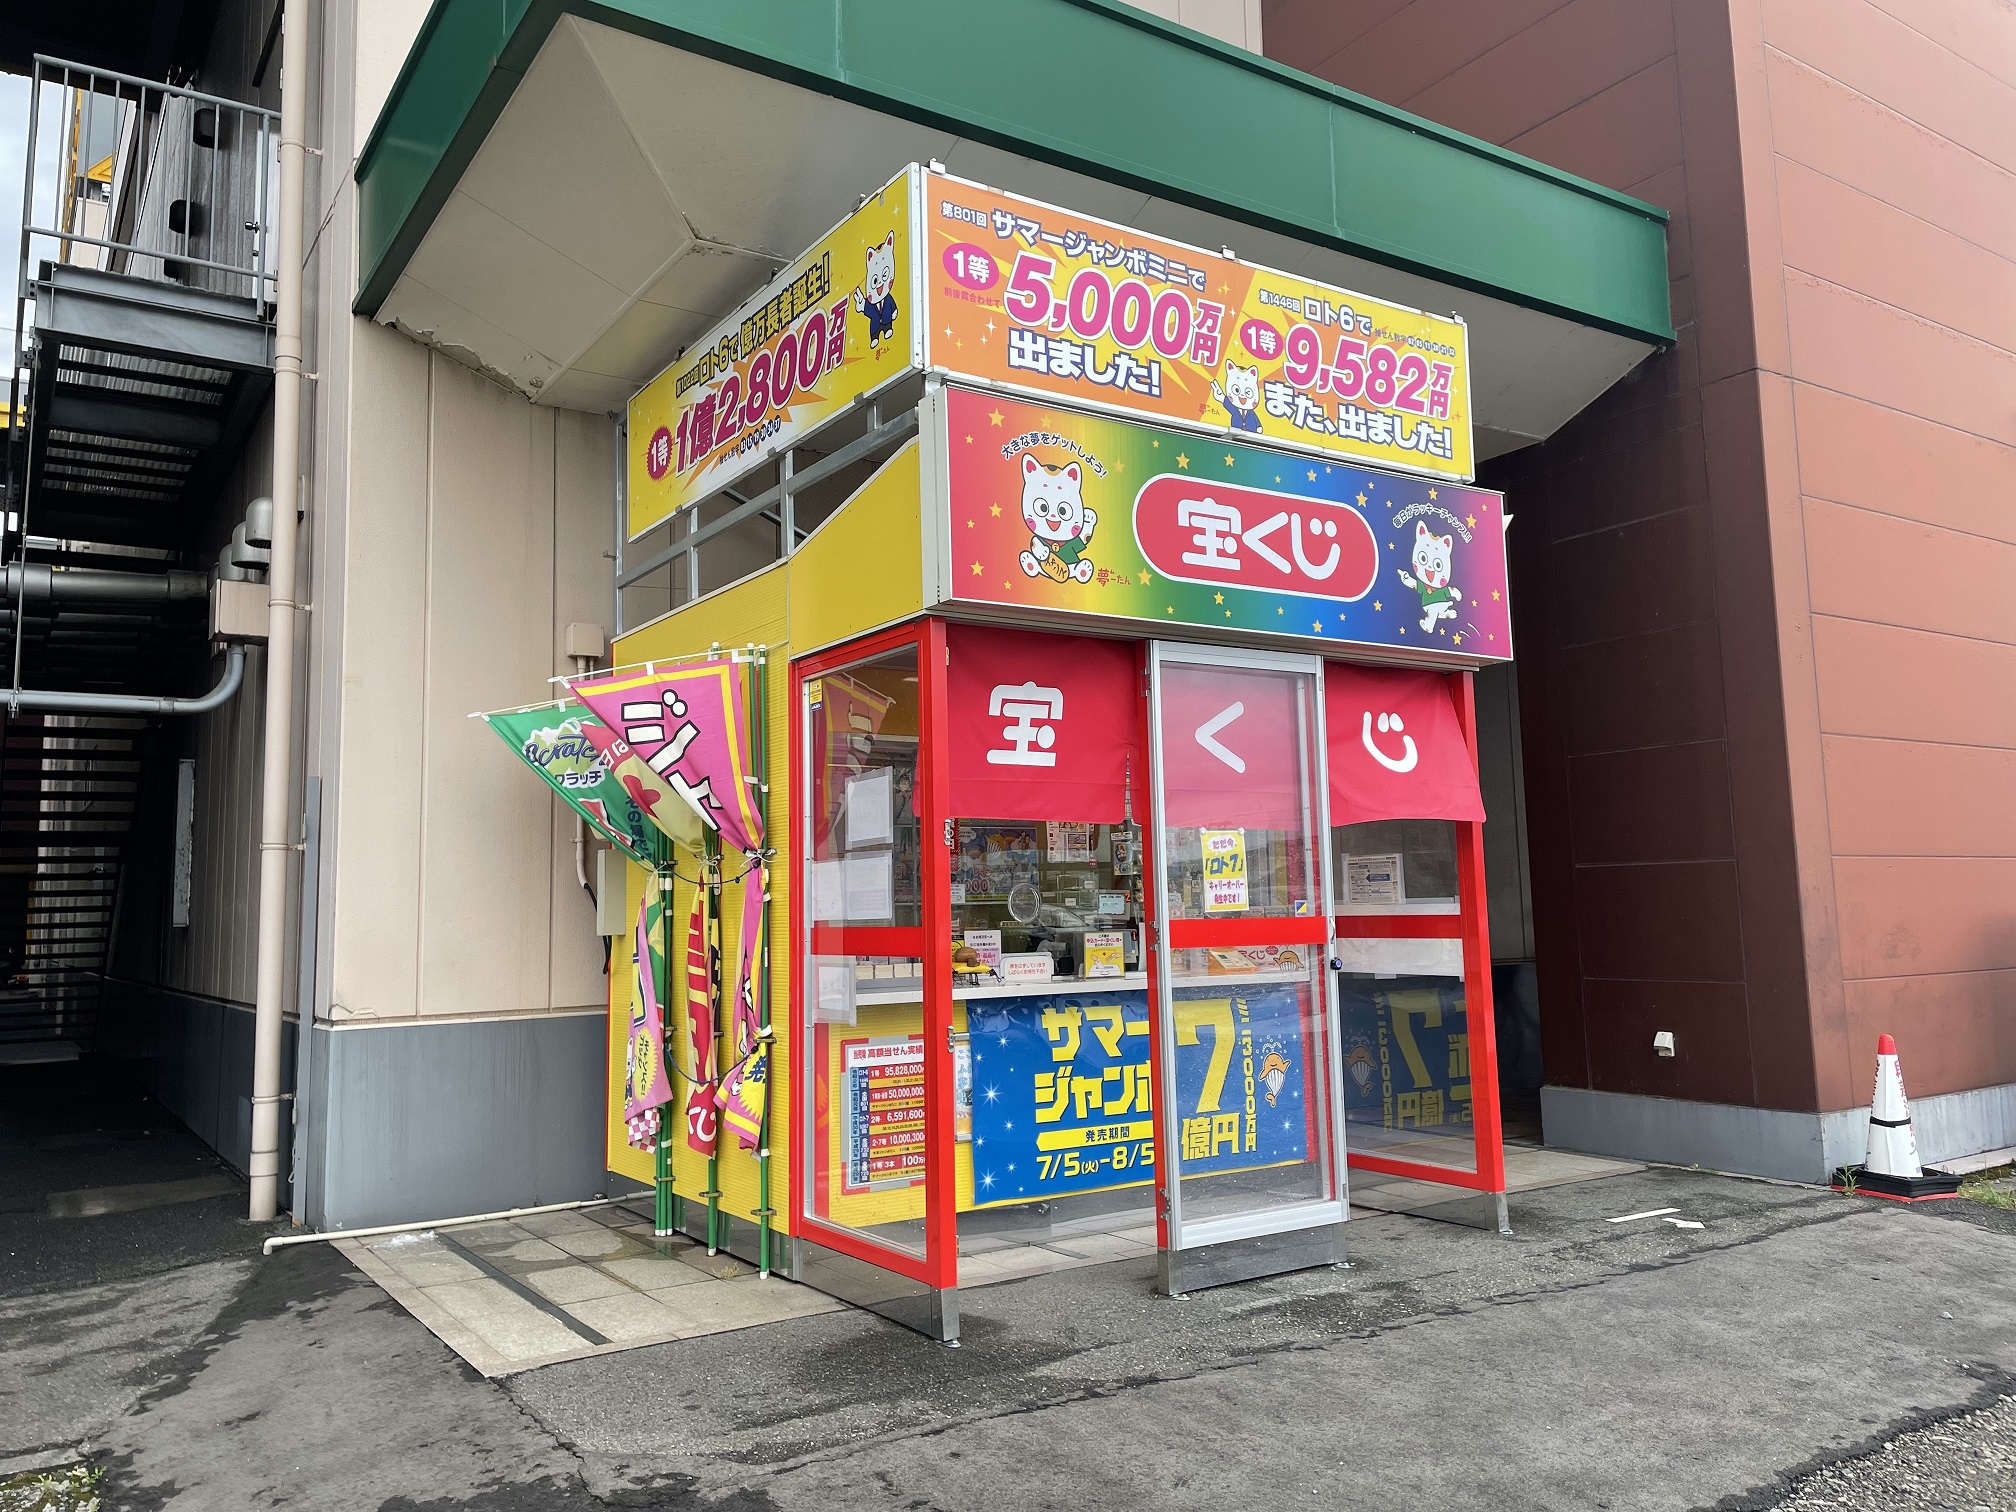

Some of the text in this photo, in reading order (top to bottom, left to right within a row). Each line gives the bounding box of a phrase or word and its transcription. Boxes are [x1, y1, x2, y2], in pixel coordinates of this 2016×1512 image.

[941, 201, 1206, 291] 第801回 サマージャンボミニで
[953, 250, 990, 284] 1等
[1259, 288, 1372, 337] 第1446回 ロト6で
[1247, 326, 1276, 354] 1等
[699, 331, 739, 387] ロト6で
[651, 437, 668, 473] 1等
[1001, 432, 1108, 479] 大きな夢をゲットしよう!
[1177, 497, 1341, 580] 宝くじ
[987, 681, 1418, 774] 宝 く じ
[1209, 880, 1244, 890] キャリーオーバー
[1041, 1005, 1150, 1062] サマー
[884, 1064, 924, 1077] 95,828,000
[1173, 998, 1240, 1161] 7 億円
[889, 1086, 924, 1099] 50,000,000
[887, 1109, 925, 1122] 6,591,600
[890, 1132, 925, 1144] 10,000,300
[1085, 1126, 1130, 1142] 発売期間
[902, 1156, 925, 1166] 100万
